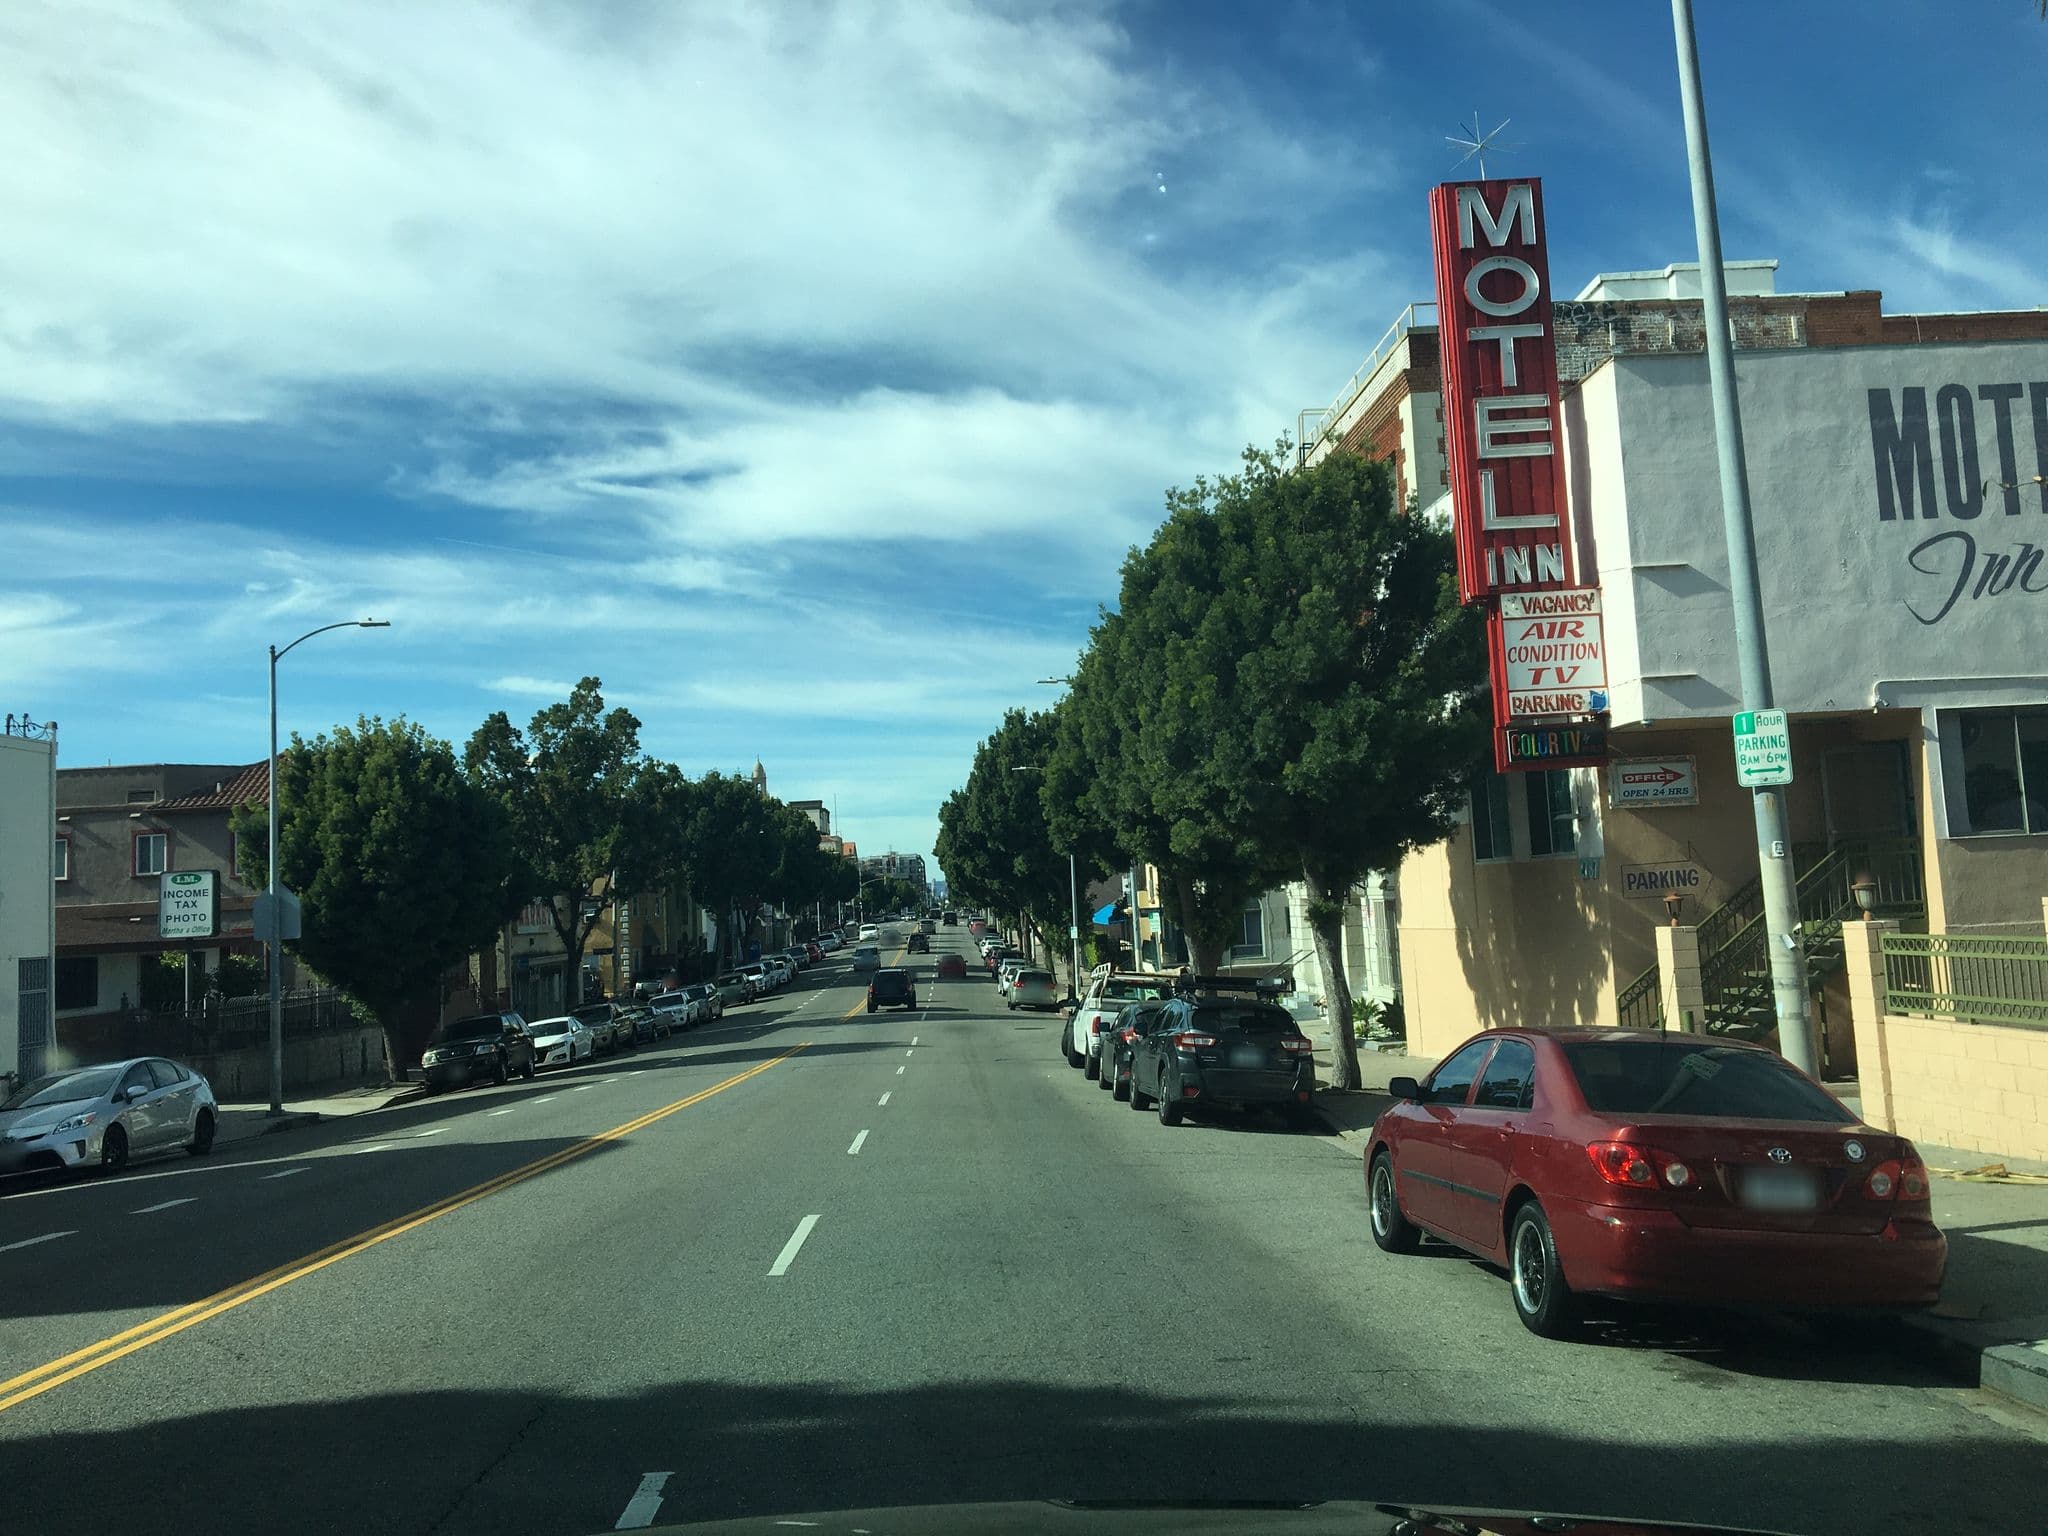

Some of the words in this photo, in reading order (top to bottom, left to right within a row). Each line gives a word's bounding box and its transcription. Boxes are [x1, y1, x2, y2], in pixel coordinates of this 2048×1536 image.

[1456, 186, 1560, 530] MOTEL
[1487, 542, 1565, 587] INN
[1520, 592, 1595, 615] VACANCY
[1519, 620, 1585, 641] AIR
[1507, 642, 1599, 664] CONDITION
[1527, 666, 1580, 686] TV
[1511, 693, 1583, 714] PARKING
[1740, 716, 1747, 732] 1
[1755, 715, 1783, 727] HOUR
[1511, 731, 1560, 757] COLOR
[1560, 729, 1580, 753] TV
[1738, 734, 1785, 752] PARKING
[1739, 754, 1760, 766] 8AM
[1766, 752, 1787, 764] 6PM
[1625, 773, 1674, 783] OFFICE
[1623, 788, 1649, 798] OPEN
[1652, 788, 1665, 796] 24
[1668, 787, 1689, 796] HRS
[1626, 868, 1700, 891] PARKING
[163, 888, 209, 899] INCOME
[174, 900, 198, 909] TAX
[165, 913, 207, 923] PHOTO
